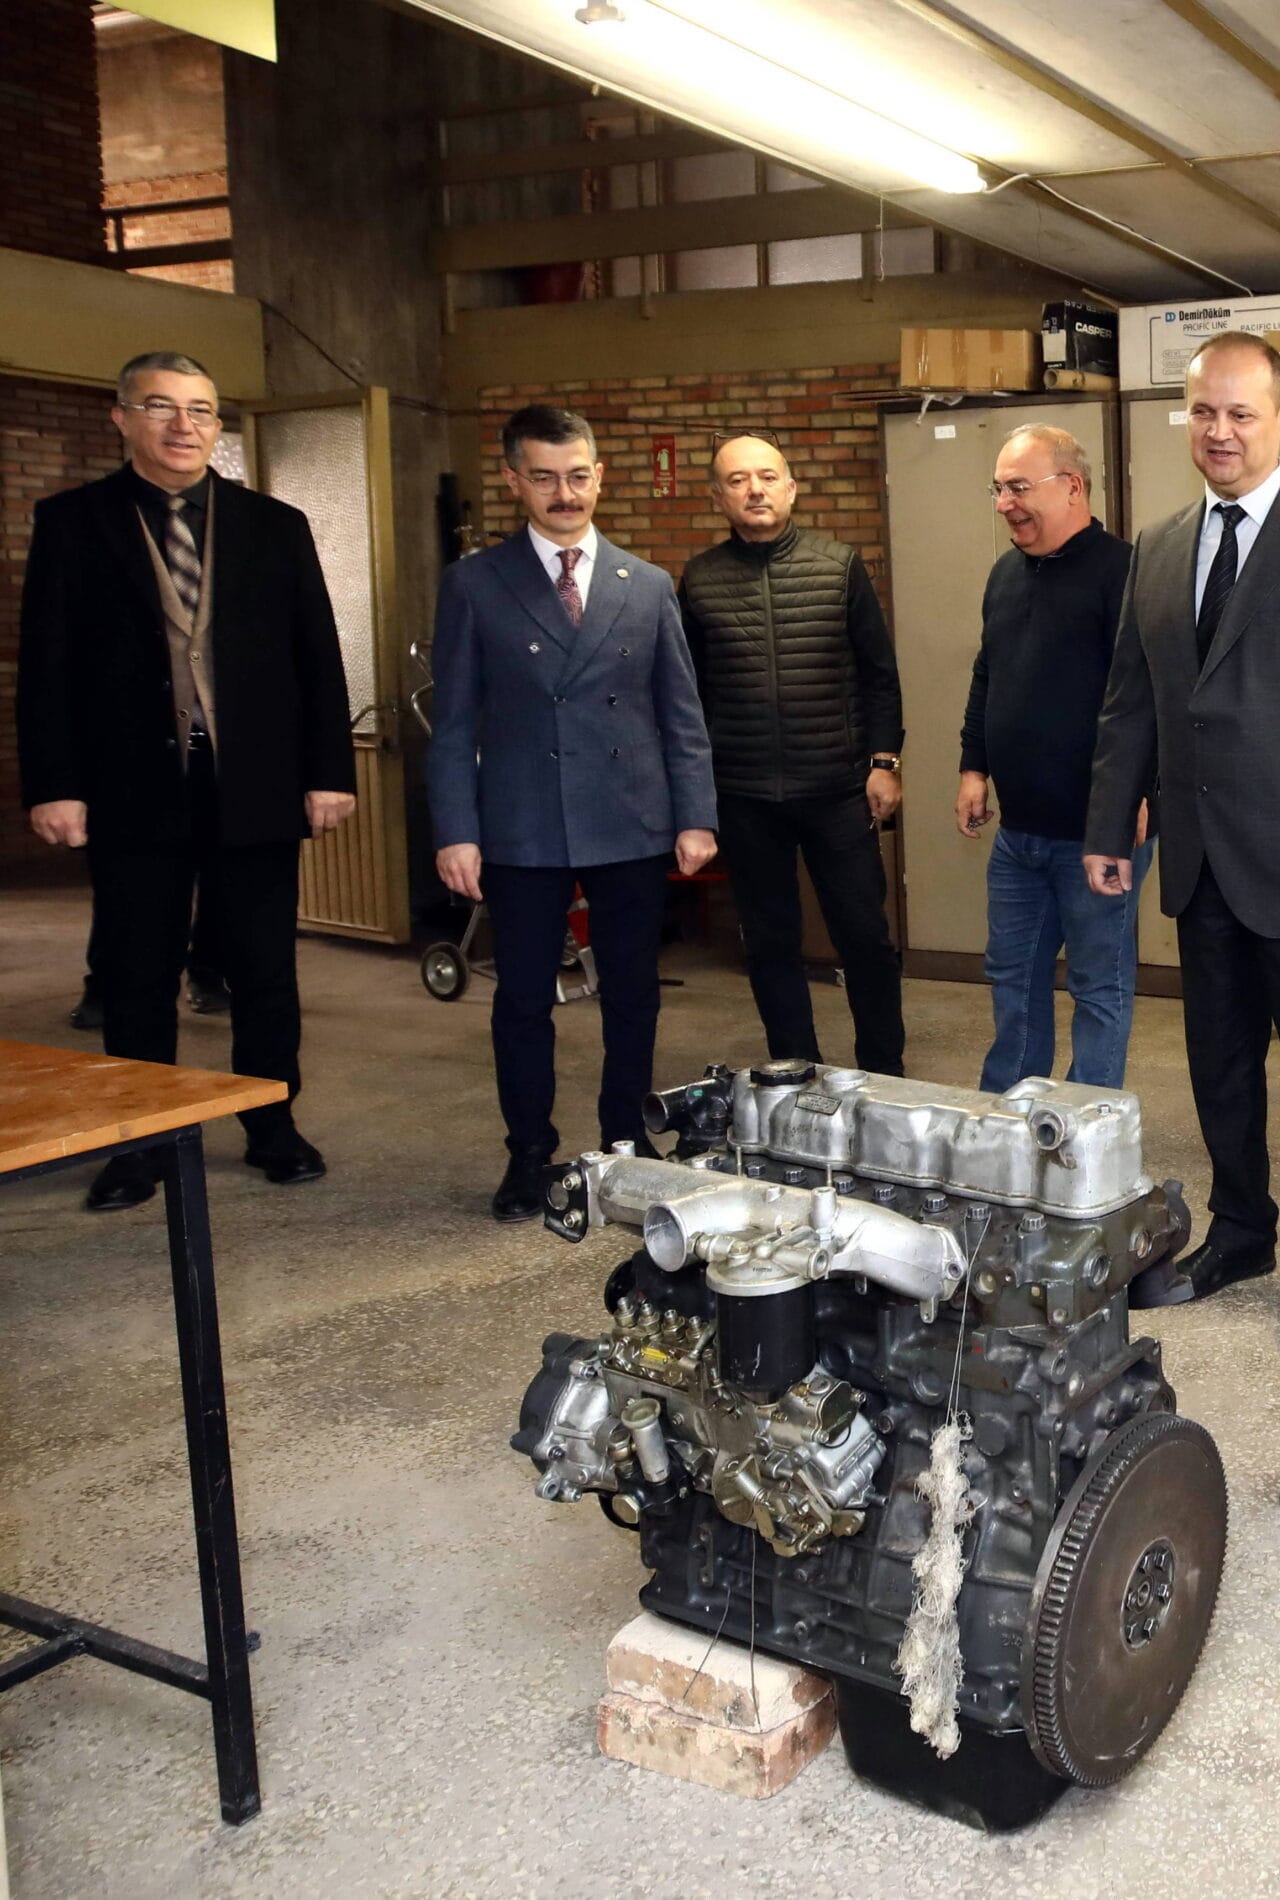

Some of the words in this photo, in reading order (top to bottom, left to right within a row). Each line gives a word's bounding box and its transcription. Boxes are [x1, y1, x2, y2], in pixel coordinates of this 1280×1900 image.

[1179, 308, 1231, 321] DemirDöküm
[1075, 321, 1112, 338] CASPER
[1183, 321, 1211, 331] PACIFIC
[1212, 320, 1228, 329] LINE
[1240, 322, 1272, 331] PACIFIC
